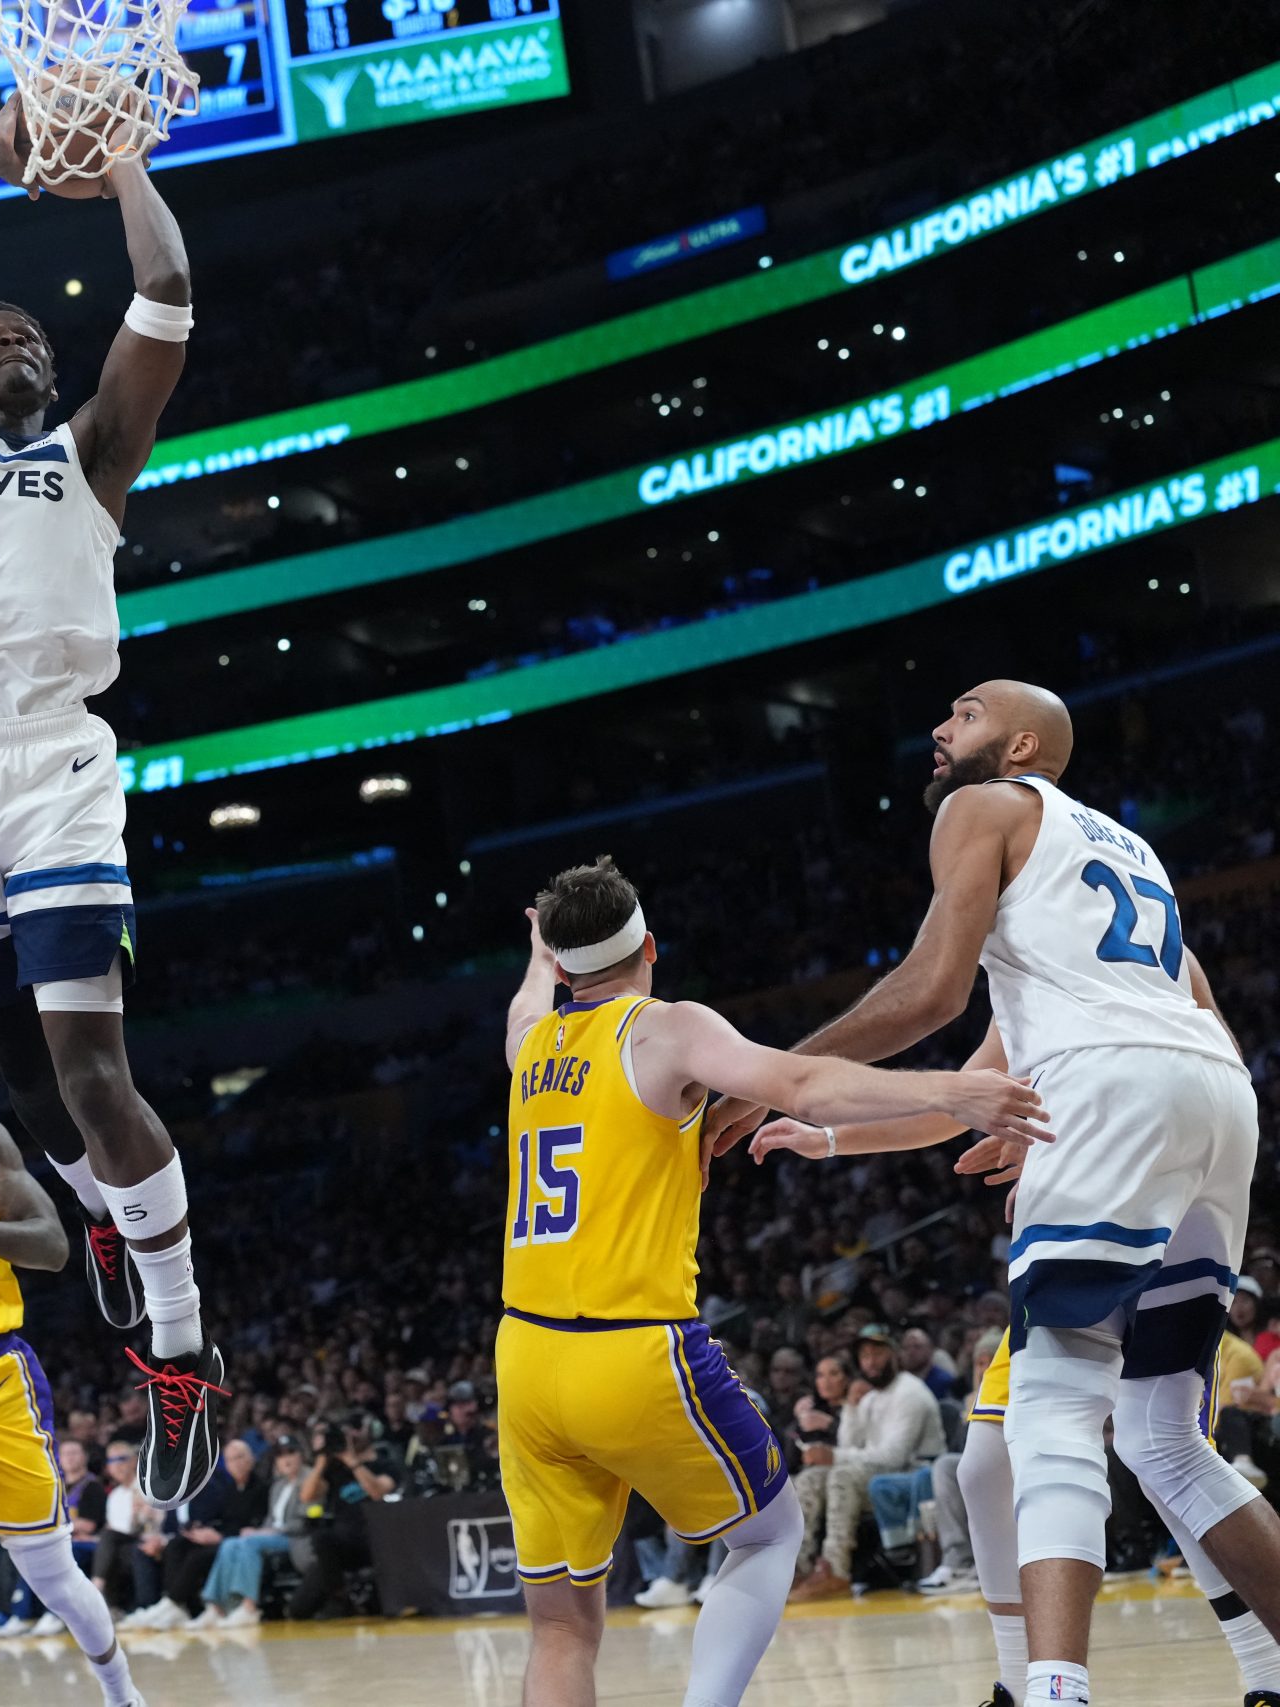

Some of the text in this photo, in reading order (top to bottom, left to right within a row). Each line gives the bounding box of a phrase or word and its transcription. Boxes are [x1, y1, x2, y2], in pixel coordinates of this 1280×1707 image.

[224, 43, 246, 84] 7
[840, 138, 1135, 283] CALIFORNIA'S #1
[639, 386, 951, 503] CALIFORNIA'S #1
[944, 467, 1260, 593] CALIFORNIA'S #1
[1081, 859, 1183, 982] 27
[521, 1056, 591, 1104] REAVES
[123, 1203, 148, 1222] 5
[511, 1122, 584, 1249] 15
